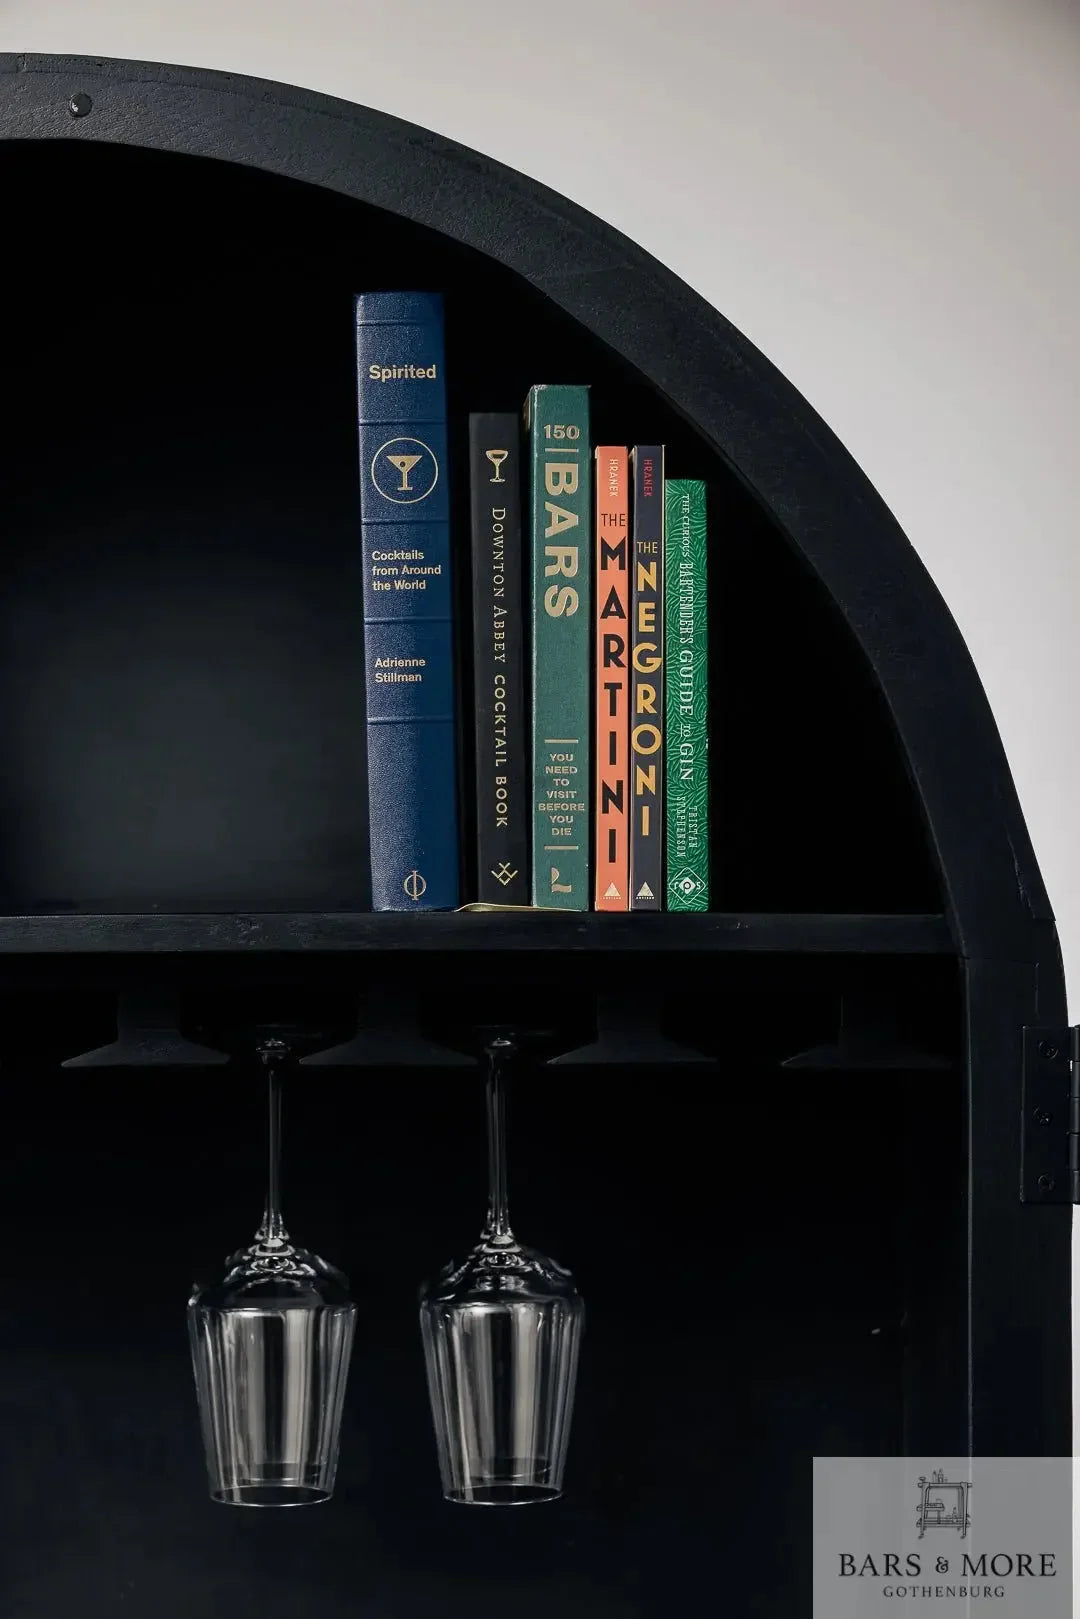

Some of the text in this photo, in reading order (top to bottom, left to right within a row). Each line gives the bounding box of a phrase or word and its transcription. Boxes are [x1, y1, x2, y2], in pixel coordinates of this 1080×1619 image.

[369, 364, 437, 382] Spirited
[543, 424, 580, 440] 150
[609, 459, 619, 497] HRANEK
[643, 459, 653, 497] HRANEK
[544, 462, 579, 617] BARS
[371, 550, 424, 561] Cocktails
[371, 564, 442, 576] from Around
[371, 579, 426, 591] the World
[374, 657, 426, 668] Adrienne
[374, 672, 423, 683] Stillman
[679, 649, 694, 716] GUIDE
[600, 513, 627, 864] THE MARTINI
[632, 541, 662, 836] THE NEGRONI
[494, 674, 507, 768] COCKTAIL
[549, 753, 574, 762] YOU
[679, 742, 694, 782] GIN
[545, 766, 578, 774] NEED
[553, 778, 570, 787] TO
[495, 776, 508, 828] BOOK
[546, 791, 577, 799] VISIT
[538, 803, 585, 811] BEFORE
[549, 816, 574, 824] YOU
[676, 796, 686, 858] STEPHENSON
[688, 805, 698, 848] TRISTAN
[551, 828, 572, 836] DIE
